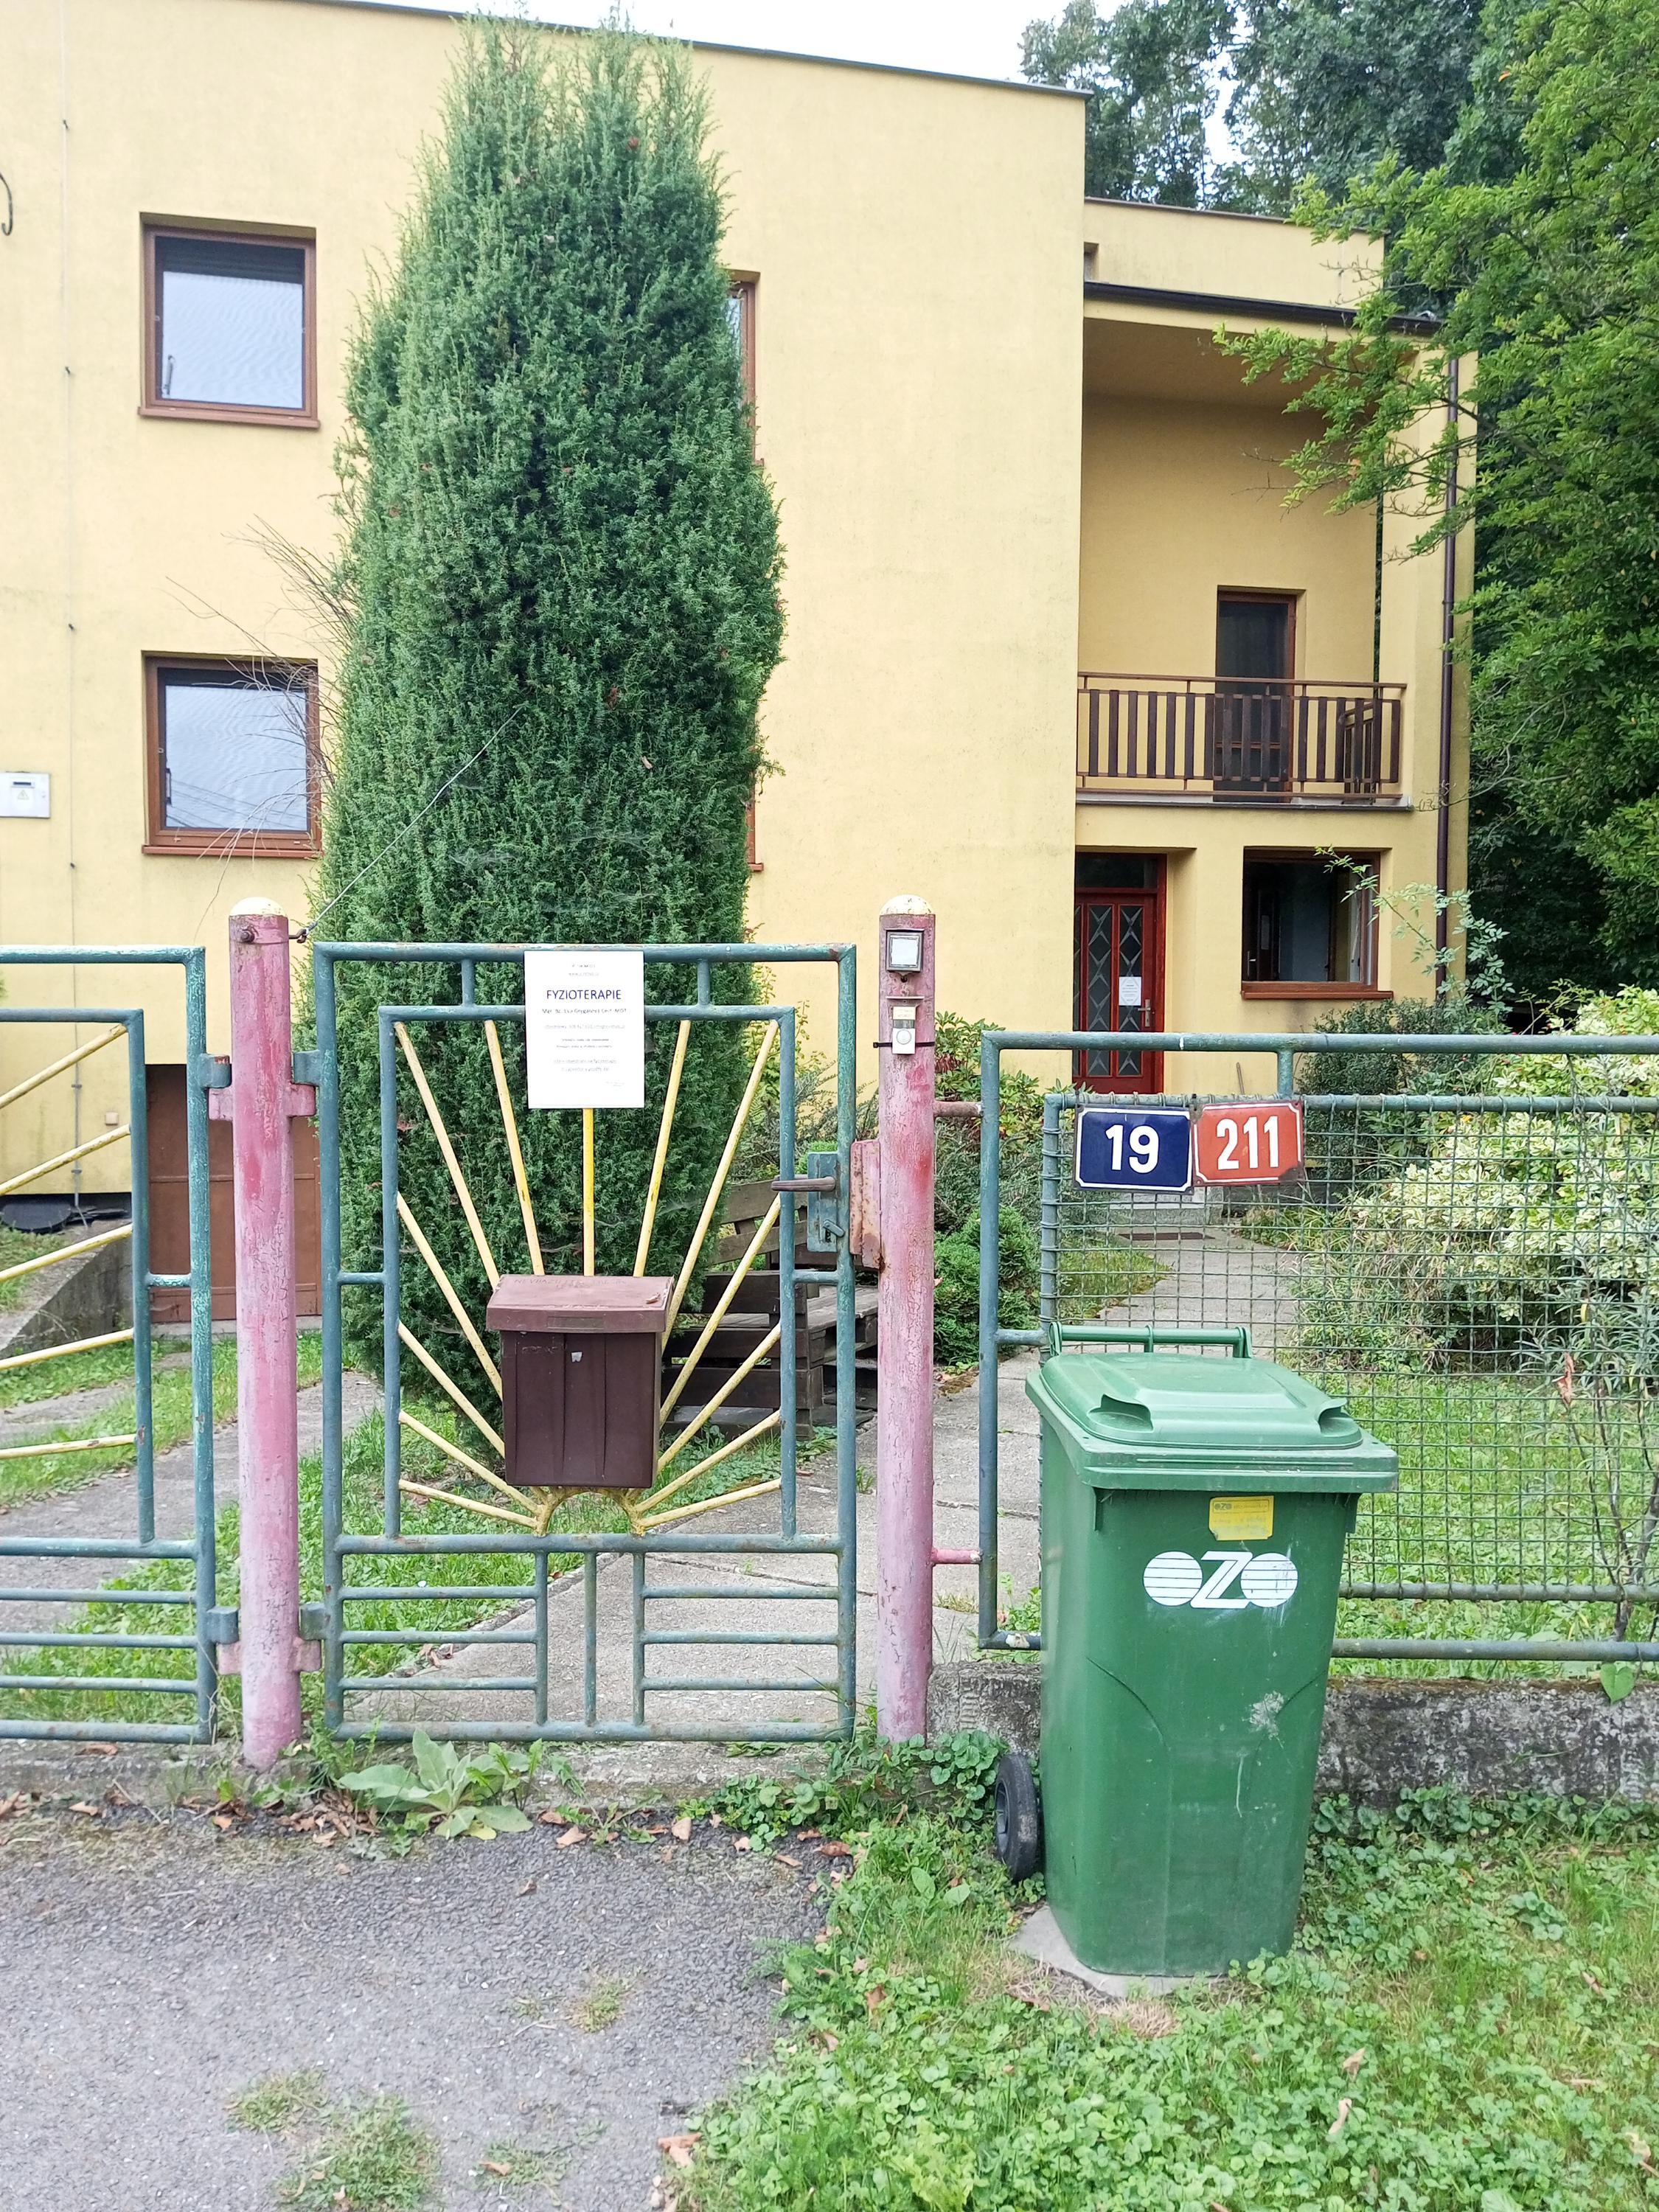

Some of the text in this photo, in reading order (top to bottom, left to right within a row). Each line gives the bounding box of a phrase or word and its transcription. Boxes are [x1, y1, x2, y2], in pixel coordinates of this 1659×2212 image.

[546, 990, 622, 1000] FYZIOTERAPIE
[1105, 1124, 1159, 1174] 19
[1217, 1116, 1279, 1170] 211
[1143, 1551, 1298, 1609] OZO
